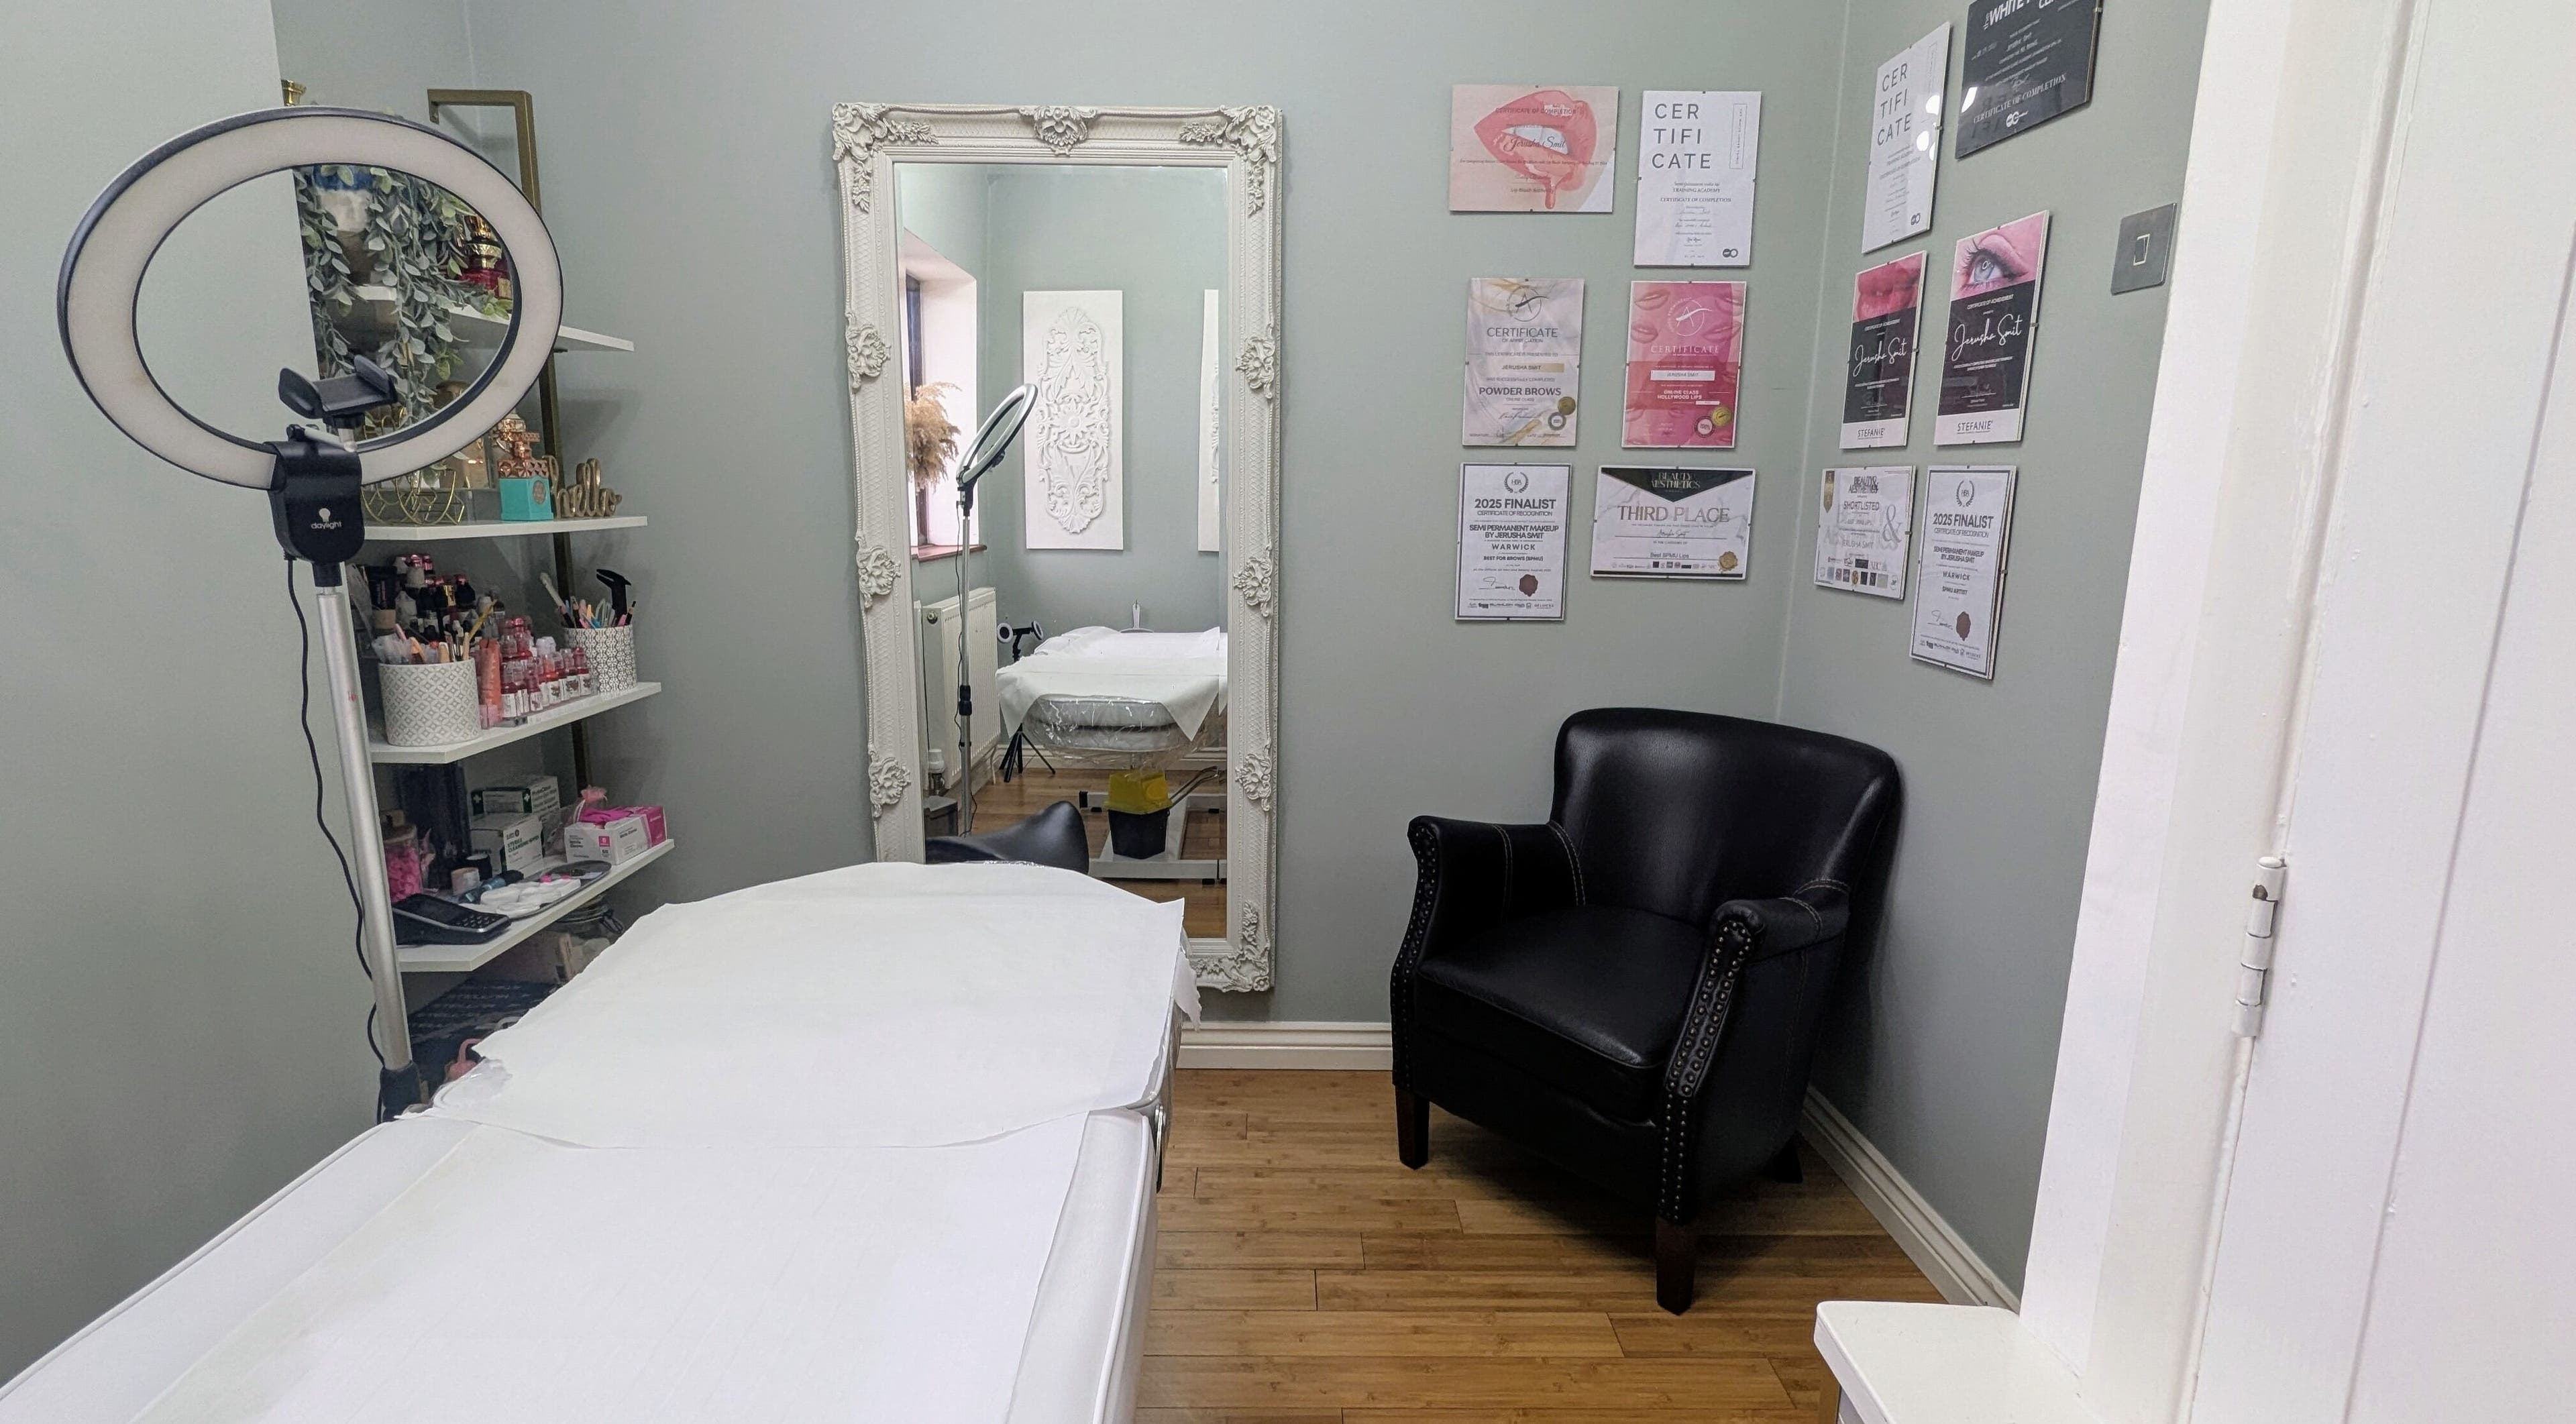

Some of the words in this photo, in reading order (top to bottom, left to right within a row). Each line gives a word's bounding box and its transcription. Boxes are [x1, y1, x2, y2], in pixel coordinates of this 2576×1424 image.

[1882, 63, 1908, 92] CER
[1542, 107, 1577, 115] COMPLETION
[1655, 103, 1699, 119] CER
[1880, 89, 1908, 119] TIFI
[1974, 100, 2011, 123] CERTIFICATE
[1654, 128, 1702, 144] TIFI
[1877, 113, 1911, 146] CATE
[1652, 153, 1711, 169] CATE
[1487, 327, 1558, 337] CERTIFICATE
[1951, 318, 1996, 362] Jerusha
[1998, 313, 2023, 345] Smit
[1651, 345, 1719, 353] CERTIFICATE
[1853, 341, 1887, 377] Jerusha
[1888, 337, 1907, 364] Smit
[1479, 387, 1522, 396] POWDER
[1525, 388, 1561, 396] BROWS
[1474, 498, 1502, 508] 2025
[1505, 499, 1556, 509] FINALIST
[1843, 500, 1880, 510] SHORTLISTED
[1617, 505, 1668, 521] THIRD
[1674, 506, 1730, 523] PLACE
[1933, 513, 1953, 526] 2025
[1953, 514, 1994, 529] FINALIST
[311, 521, 342, 530] daylight
[1942, 571, 1970, 581] WARWICK
[1953, 587, 1968, 595] ARTIST
